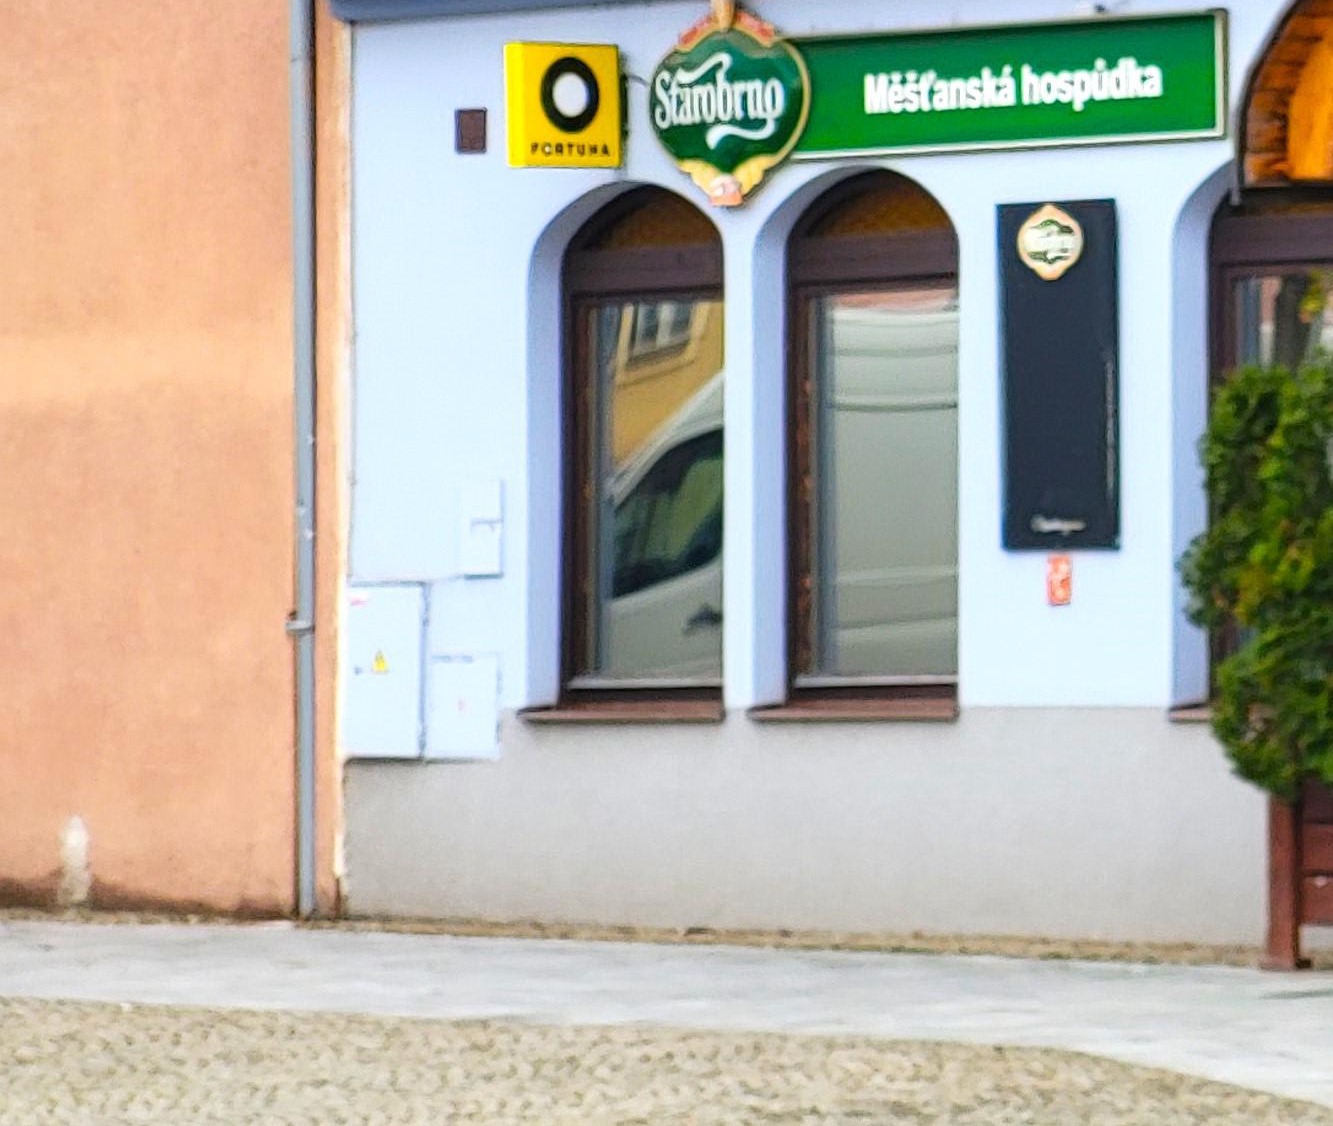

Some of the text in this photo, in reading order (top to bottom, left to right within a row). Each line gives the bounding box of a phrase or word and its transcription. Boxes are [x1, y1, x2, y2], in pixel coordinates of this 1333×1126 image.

[654, 51, 786, 150] Starobrno
[863, 56, 1163, 114] Měšťanská hospůdka
[530, 141, 610, 156] FORTUNA
